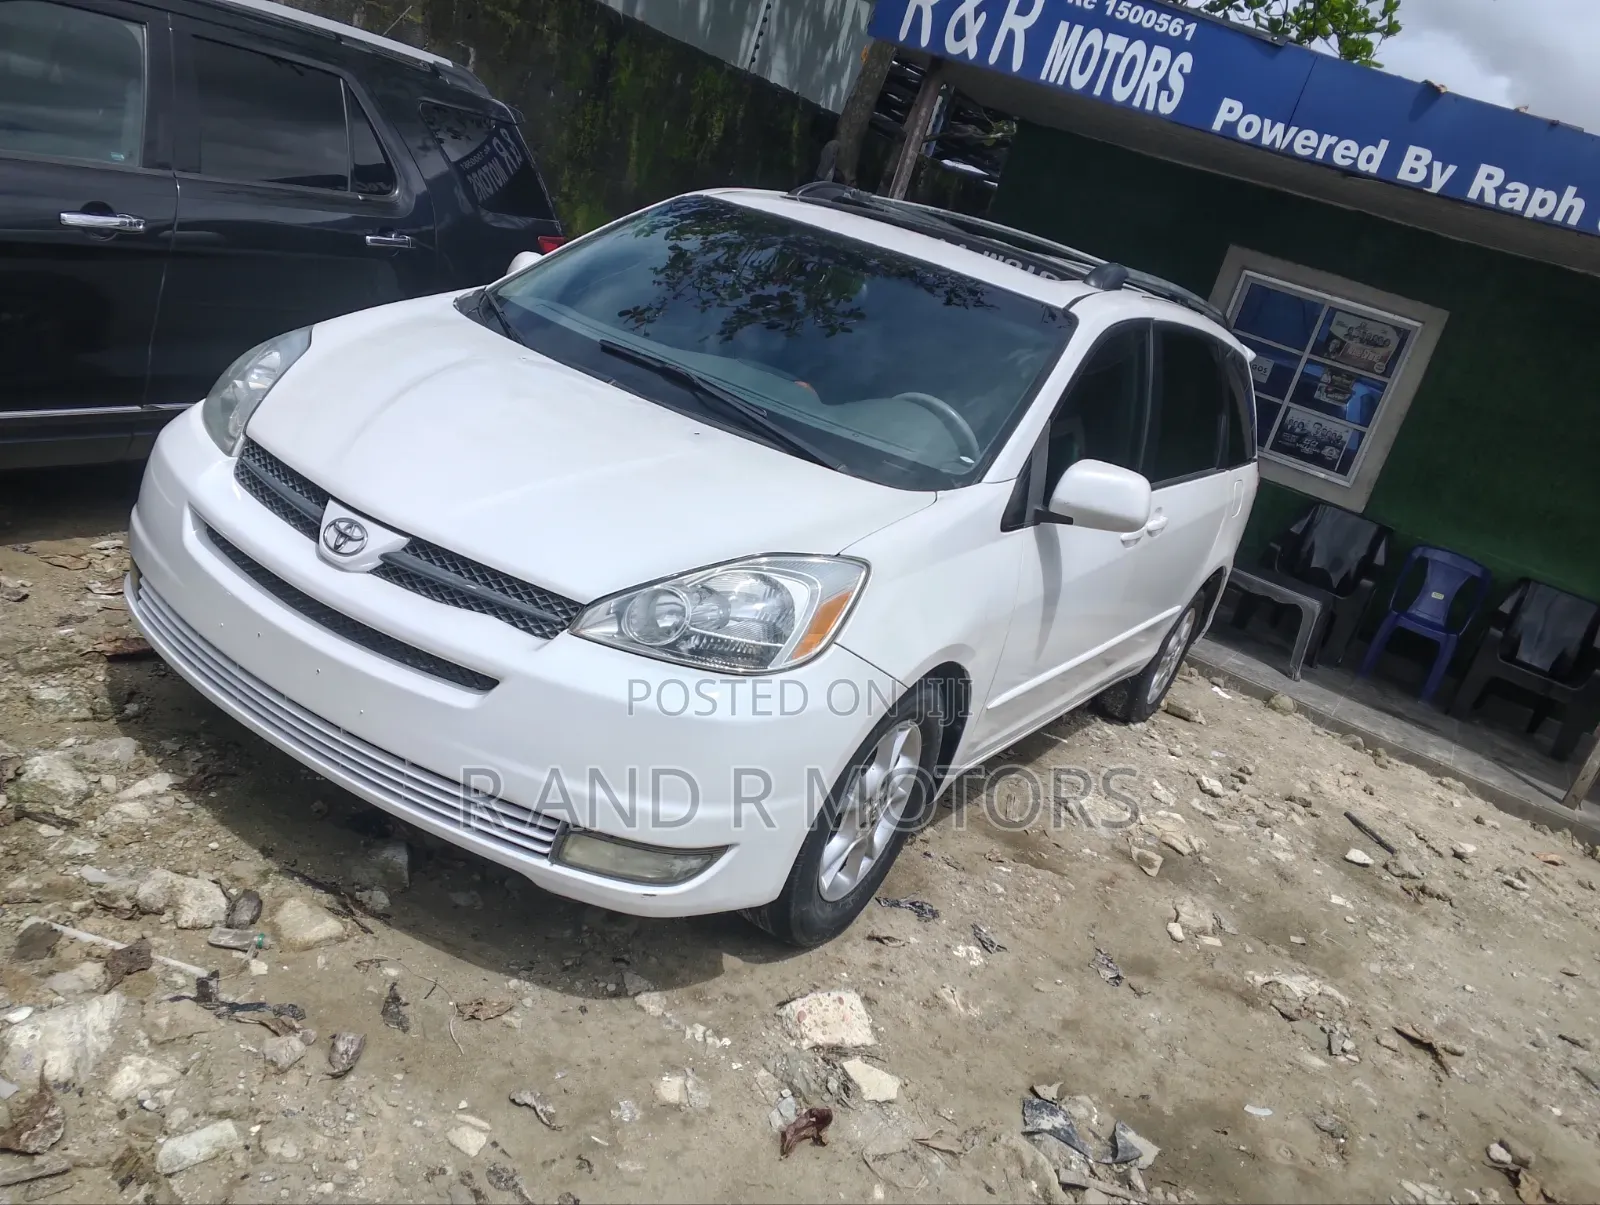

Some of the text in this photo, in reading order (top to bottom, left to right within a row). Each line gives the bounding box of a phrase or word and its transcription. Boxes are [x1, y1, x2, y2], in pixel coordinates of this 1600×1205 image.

[988, 0, 1045, 73] R
[1105, 0, 1198, 41] 1500561
[1039, 20, 1194, 115] MOTORS
[1211, 97, 1587, 227] Powered By Raph
